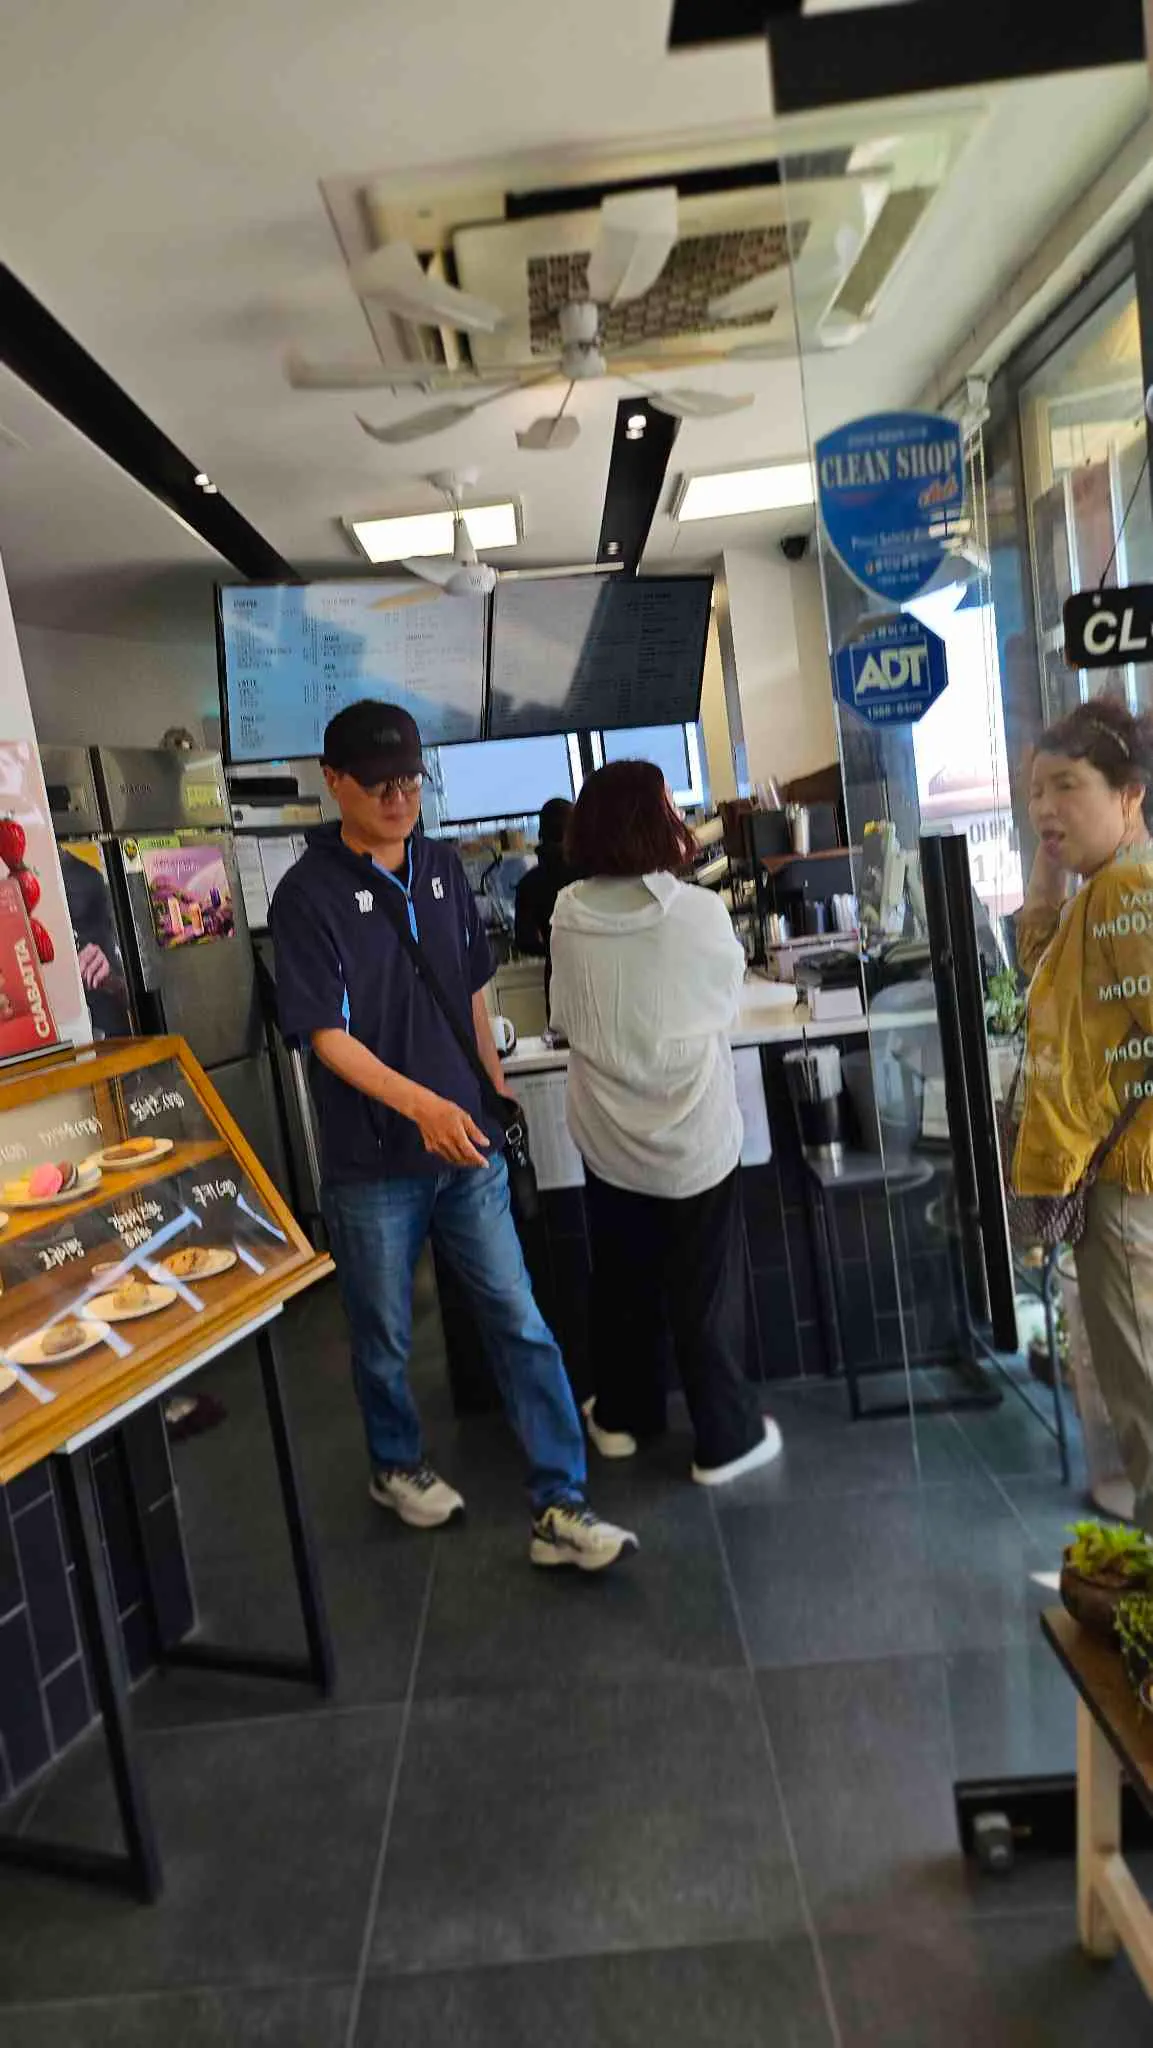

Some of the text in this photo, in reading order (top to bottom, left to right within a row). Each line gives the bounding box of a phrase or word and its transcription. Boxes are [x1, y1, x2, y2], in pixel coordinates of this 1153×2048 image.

[821, 439, 959, 490] CLEAN SHOP
[1083, 608, 1153, 655] CL
[855, 644, 927, 694] ADT
